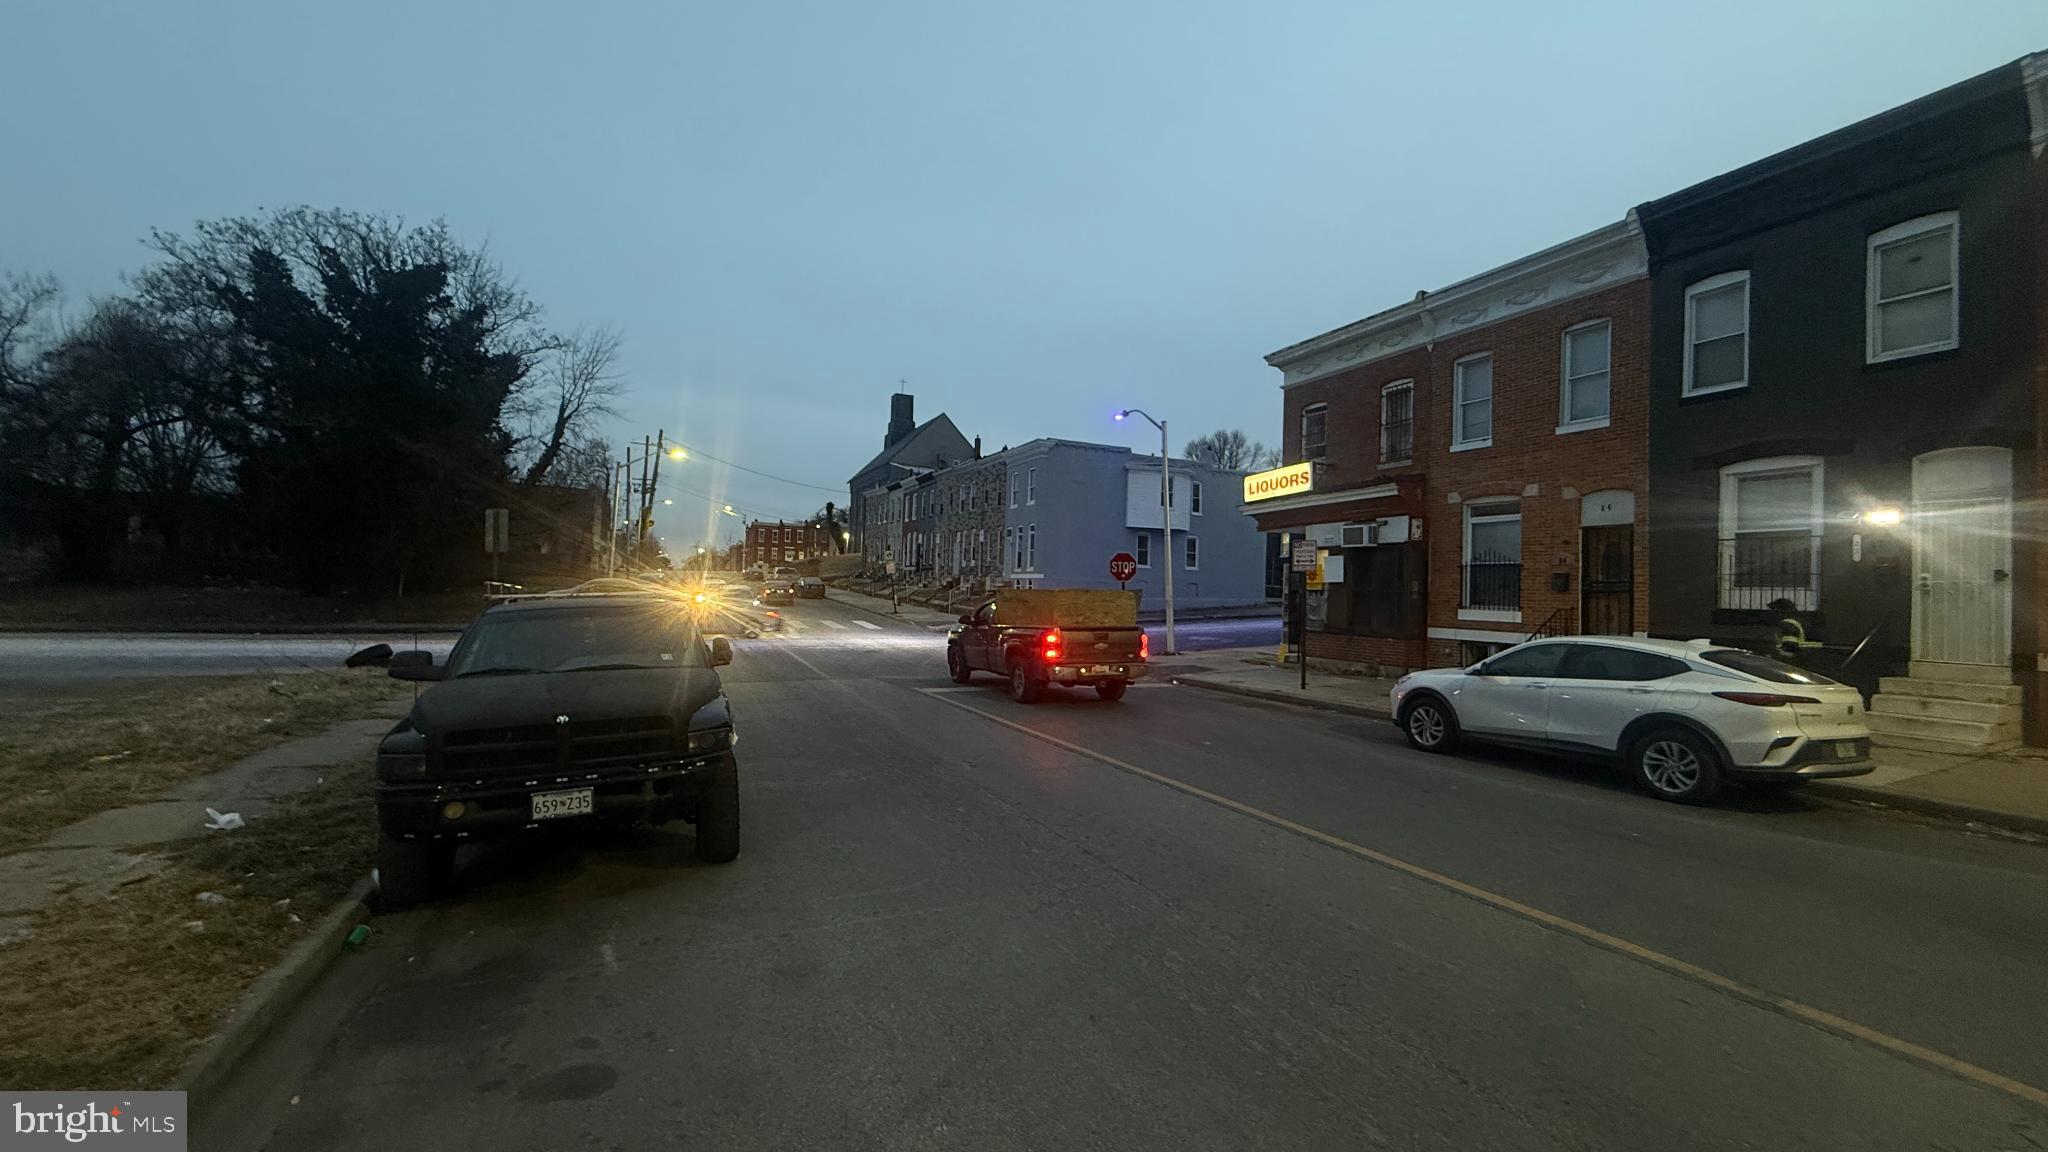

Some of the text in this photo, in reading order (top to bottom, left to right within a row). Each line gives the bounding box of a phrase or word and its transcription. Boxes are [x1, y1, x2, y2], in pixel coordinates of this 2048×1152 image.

[1249, 471, 1310, 495] LIQUORS
[1111, 561, 1136, 573] STOP
[534, 799, 558, 814] 659
